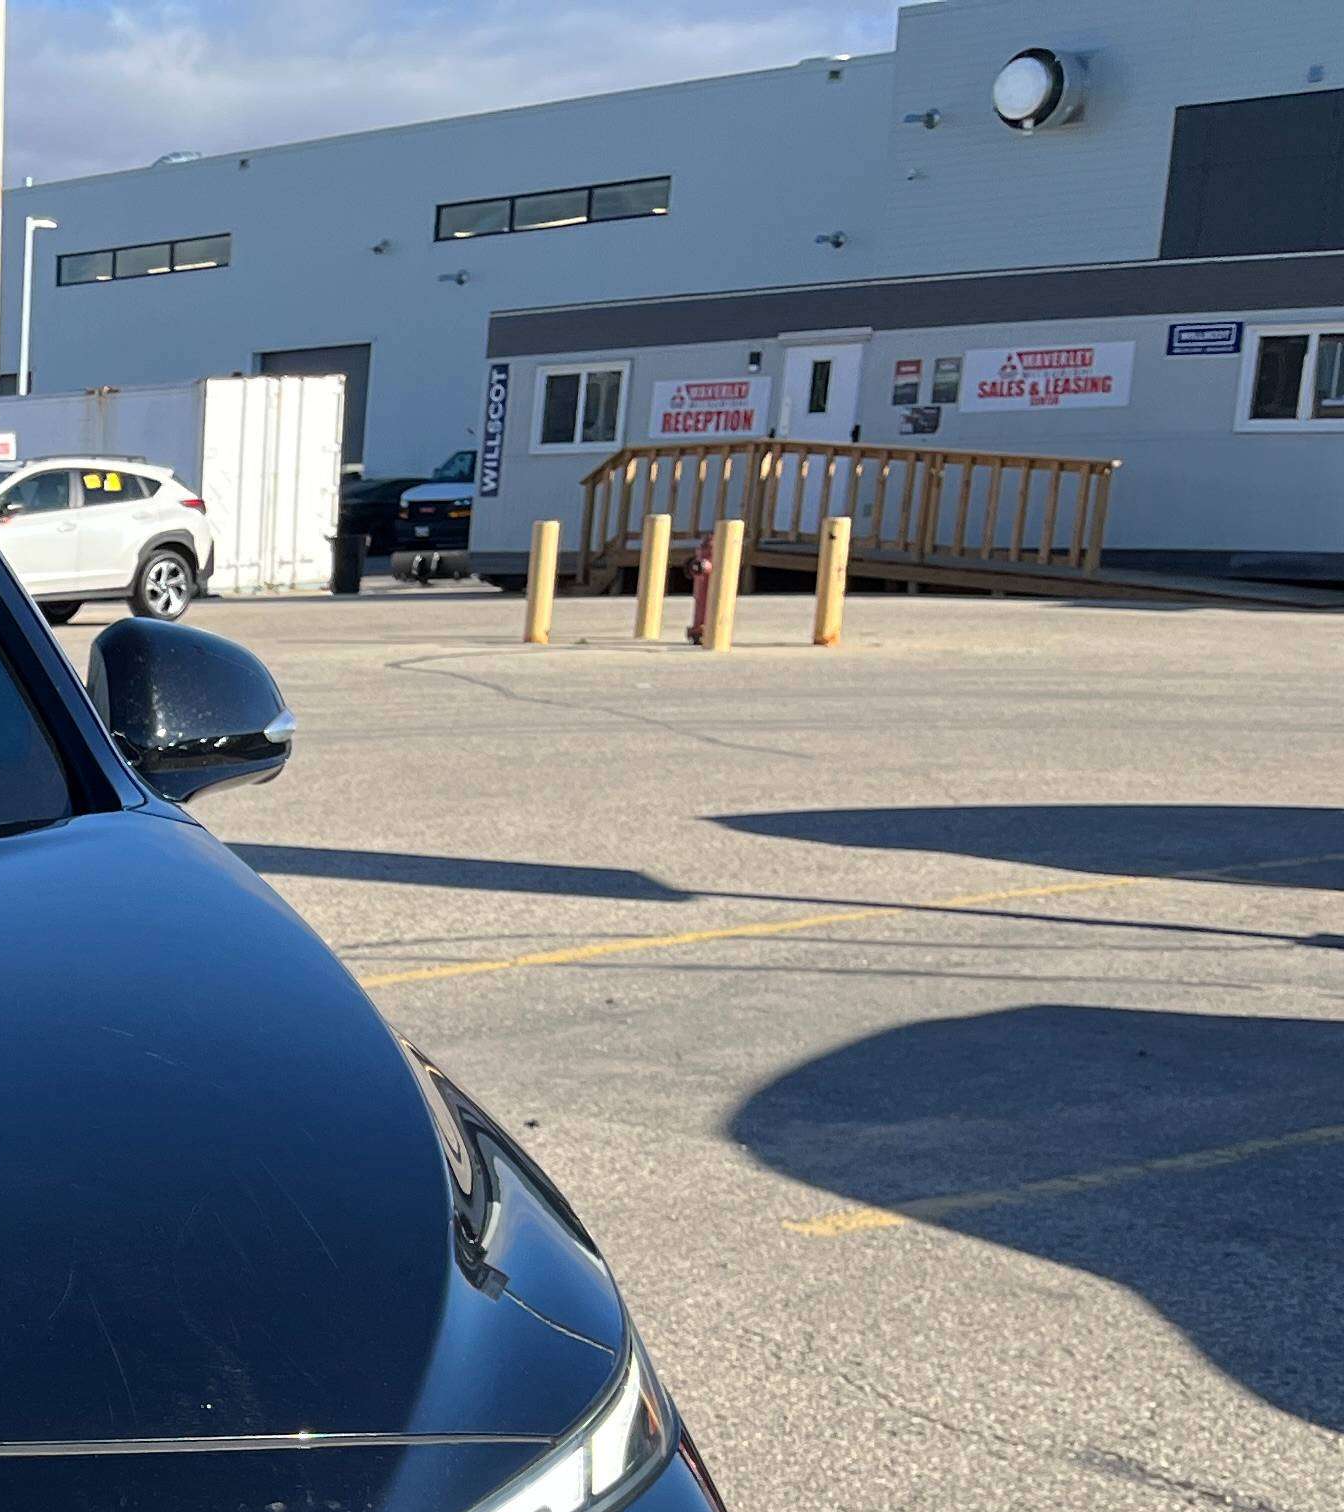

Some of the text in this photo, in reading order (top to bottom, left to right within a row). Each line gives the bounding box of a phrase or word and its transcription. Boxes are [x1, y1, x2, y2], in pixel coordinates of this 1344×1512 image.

[978, 375, 1113, 399] SALES & LEASING
[481, 368, 508, 493] WILLSCOT
[662, 409, 754, 433] RECEPTION
